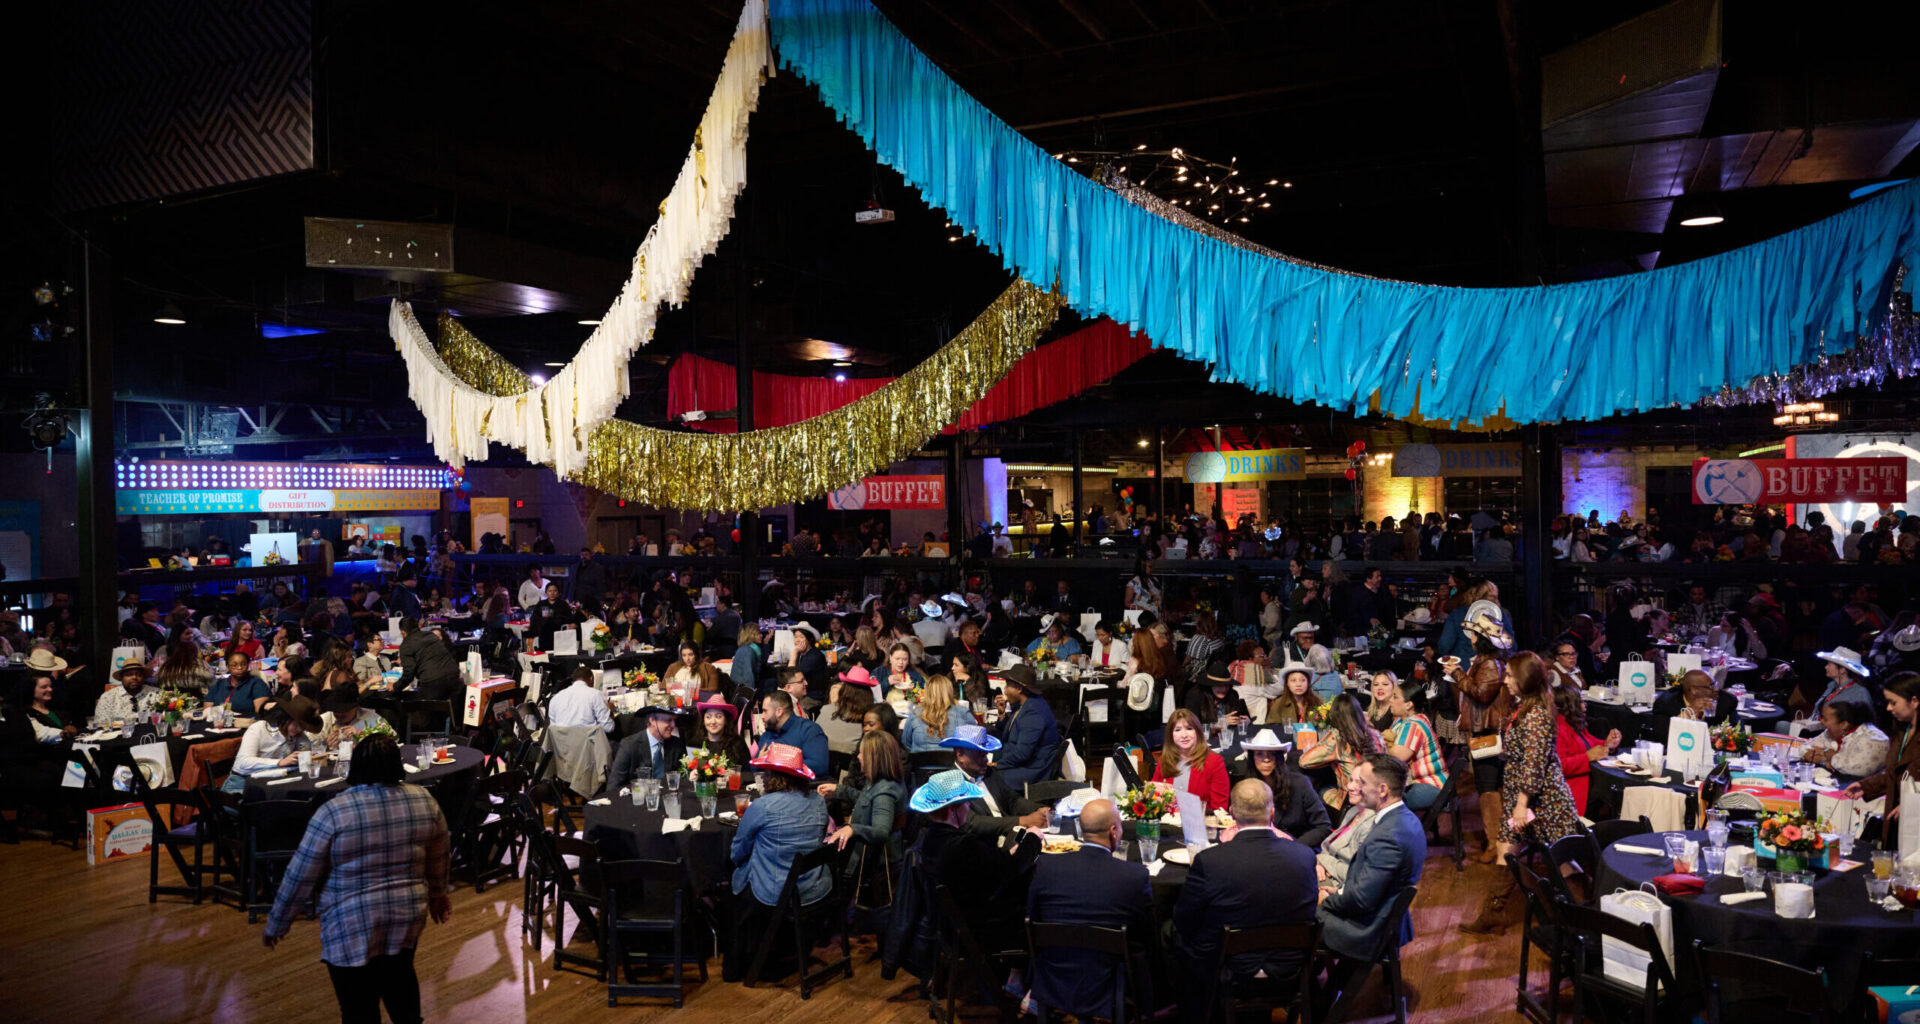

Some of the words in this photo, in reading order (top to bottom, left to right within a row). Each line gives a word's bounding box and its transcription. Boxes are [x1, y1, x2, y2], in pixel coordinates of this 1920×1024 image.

[1229, 455, 1299, 474] DRINKS
[1445, 449, 1522, 469] DRINKS
[1766, 465, 1899, 495] BUFFET
[139, 493, 187, 505] TEACHER
[188, 492, 200, 503] OF
[202, 492, 243, 503] PROMISE
[288, 492, 307, 500] GIFT
[868, 481, 941, 504] BUFFET
[268, 501, 327, 509] DISTRIBUTION
